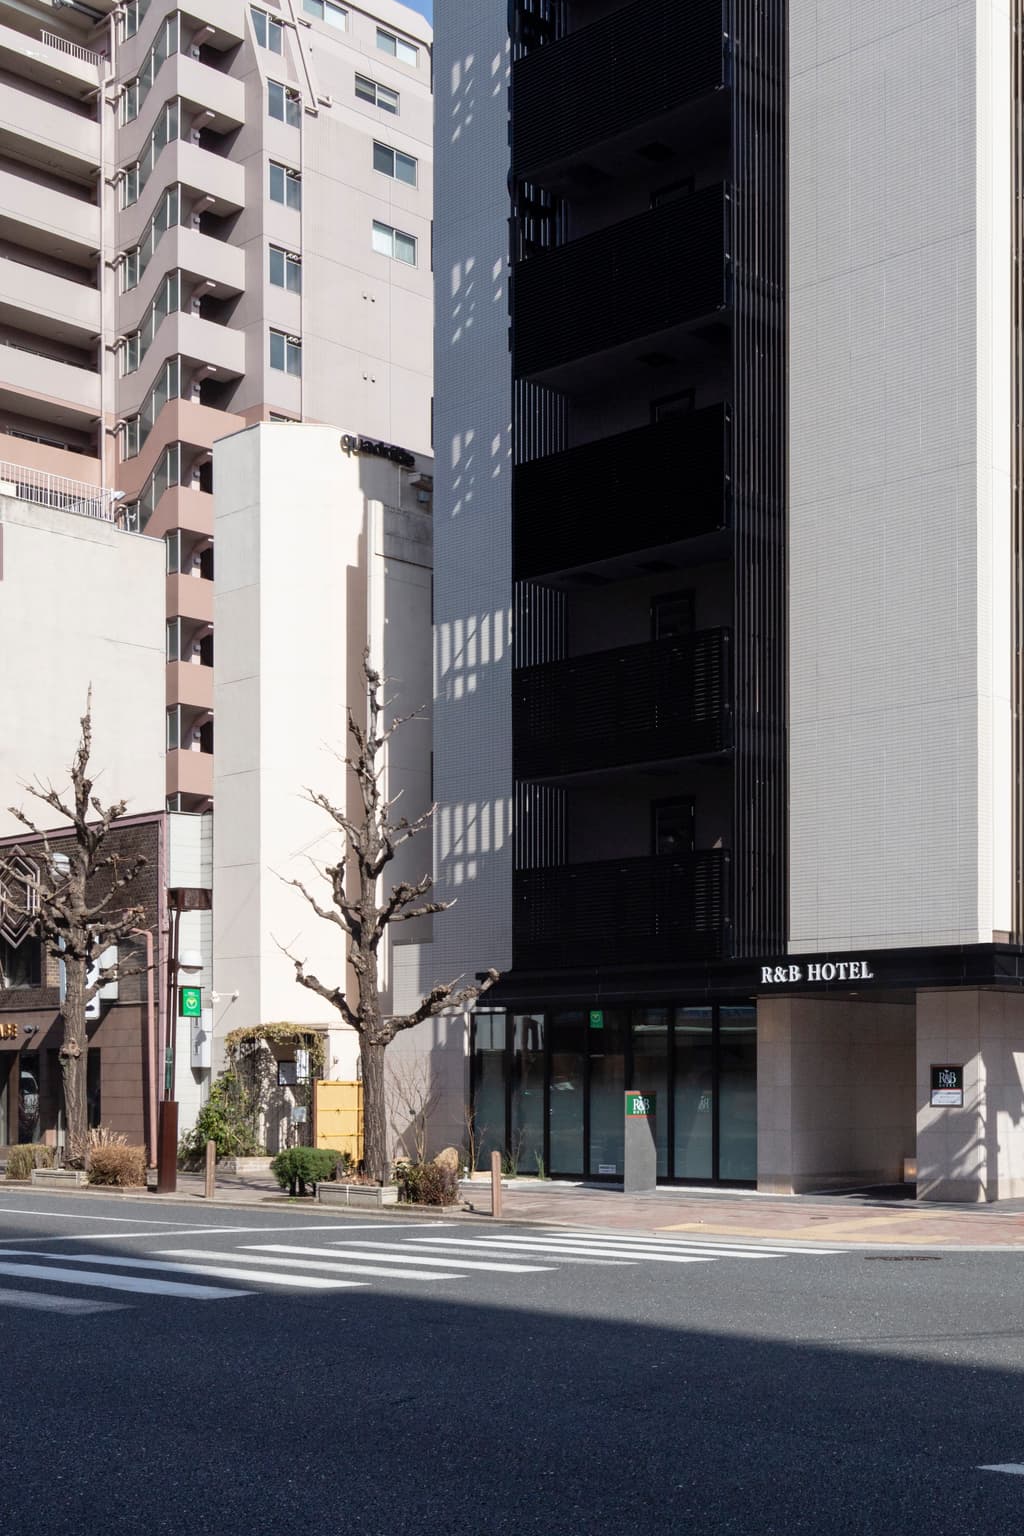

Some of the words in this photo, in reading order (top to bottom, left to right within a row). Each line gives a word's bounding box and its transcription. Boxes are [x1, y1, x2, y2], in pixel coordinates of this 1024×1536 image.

[760, 964, 802, 984] R&B
[807, 961, 874, 982] HOTEL
[632, 1097, 650, 1111] R&B
